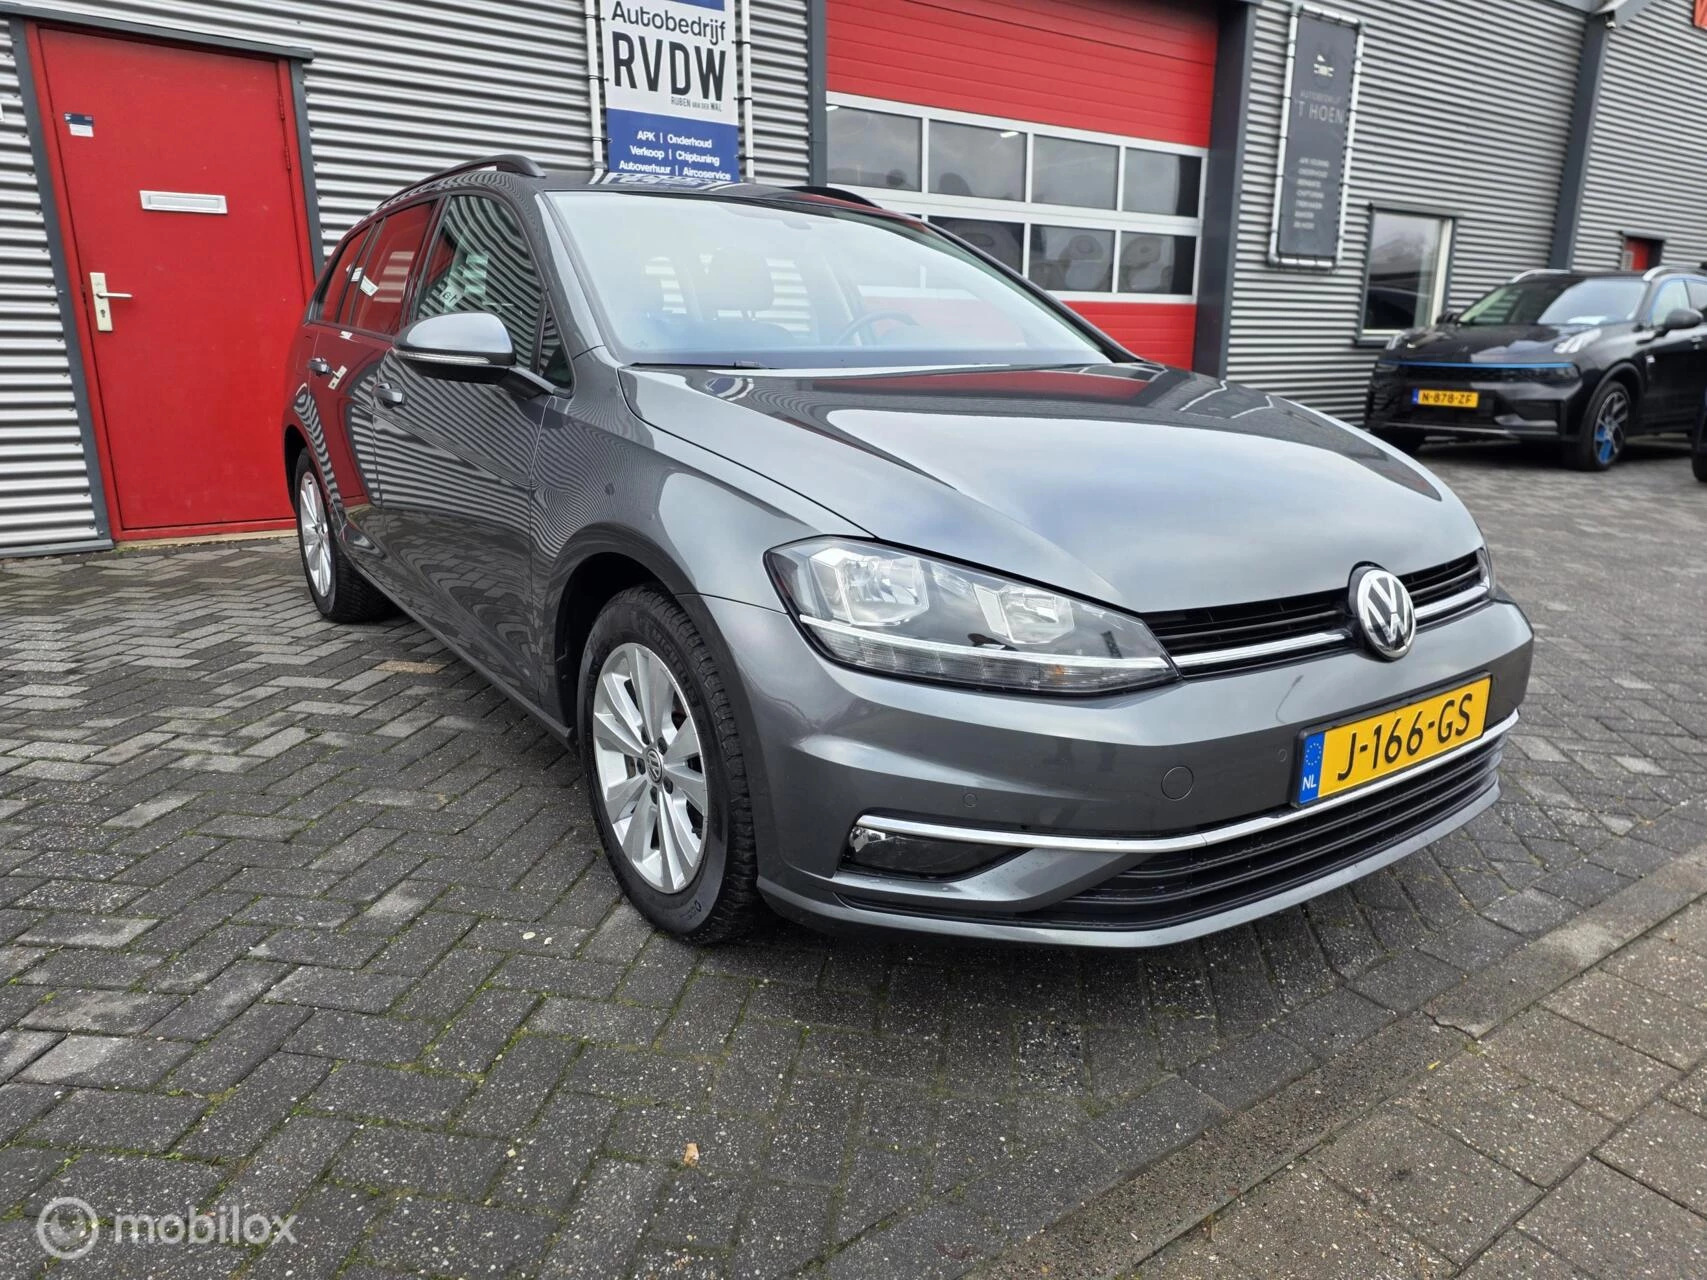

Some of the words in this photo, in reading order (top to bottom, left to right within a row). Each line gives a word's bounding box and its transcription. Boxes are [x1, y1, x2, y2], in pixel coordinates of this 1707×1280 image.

[611, 1, 726, 45] Autobedrijf
[612, 31, 726, 101] RVDW
[1309, 103, 1344, 124] HOEN
[636, 130, 655, 142] APK
[667, 134, 712, 149] Onderhoud
[630, 145, 665, 160] Verkoop
[676, 150, 720, 166] Chiptuning
[619, 160, 671, 174] Autoverhuur
[682, 167, 731, 180] Aircoservice
[1422, 391, 1472, 405] N-878-ZF
[1337, 693, 1473, 781] J-166-GS
[1302, 774, 1317, 791] NL
